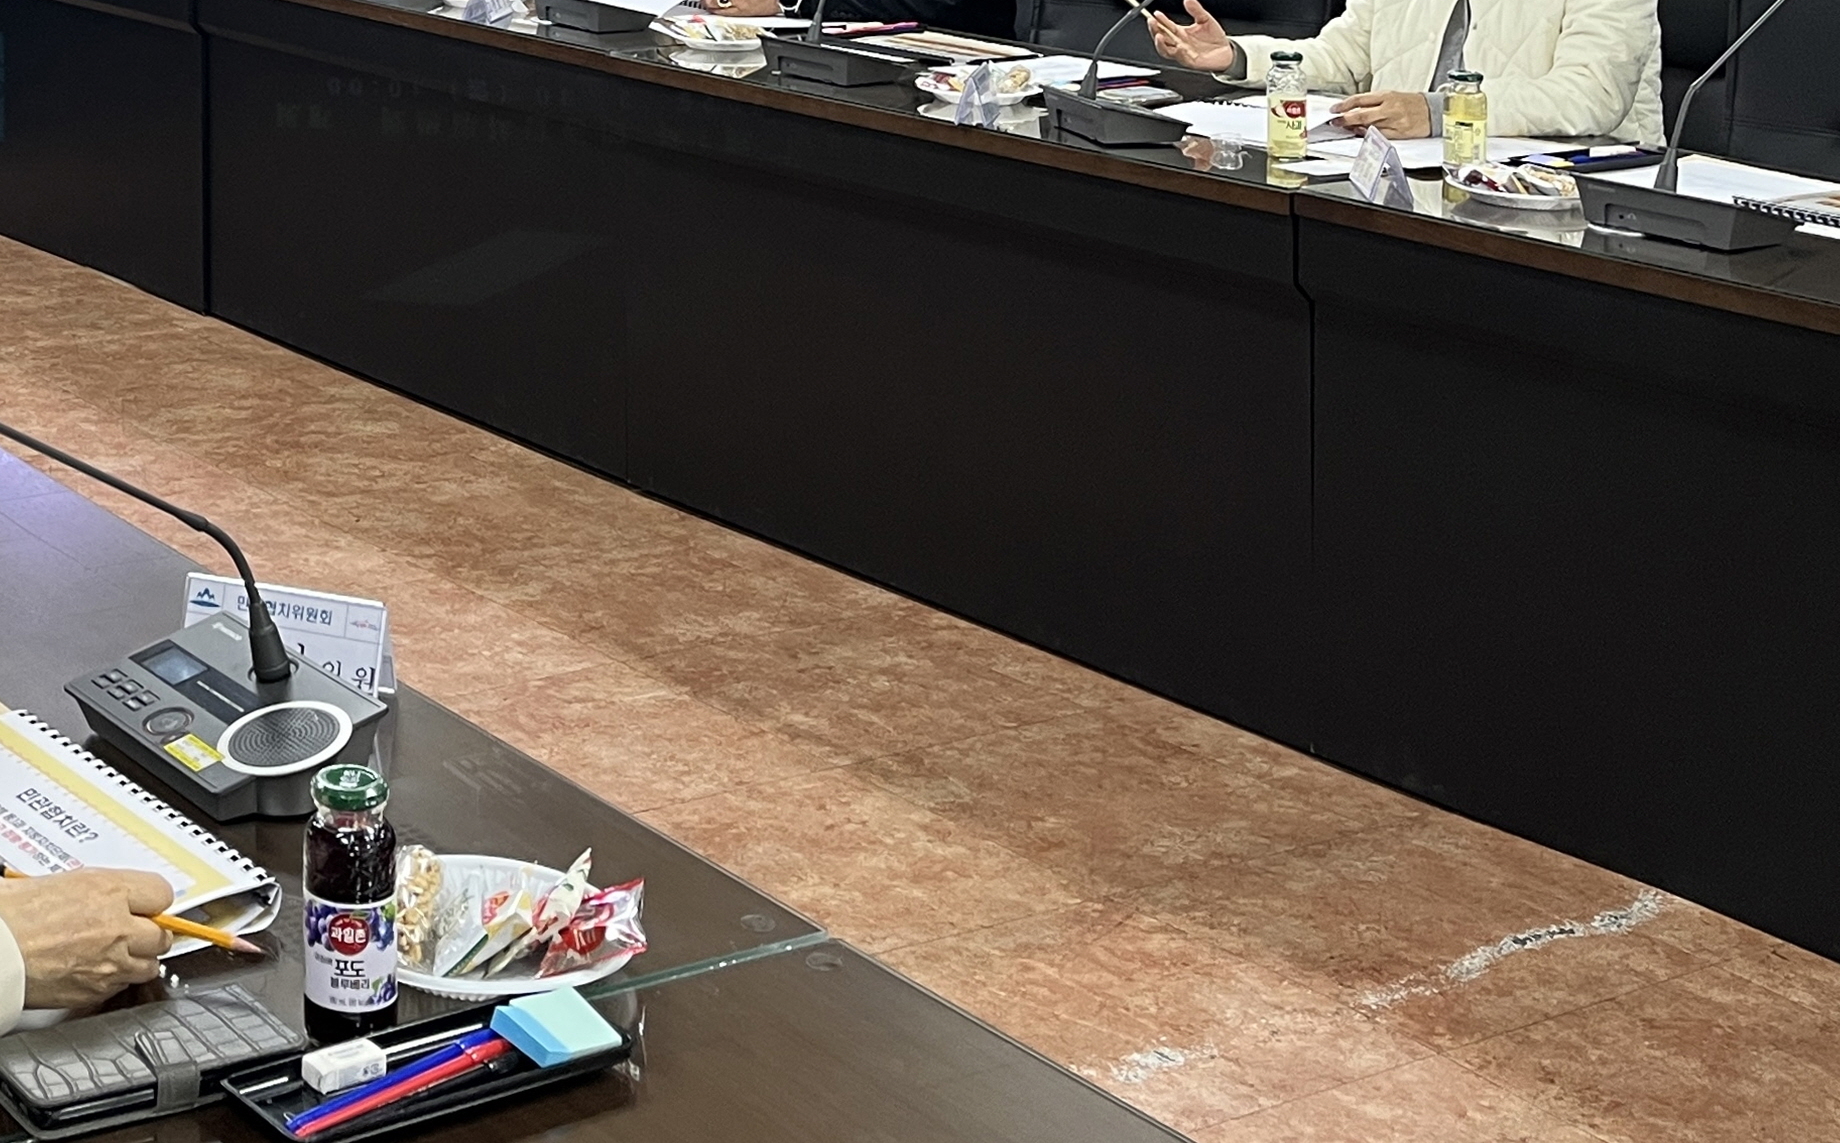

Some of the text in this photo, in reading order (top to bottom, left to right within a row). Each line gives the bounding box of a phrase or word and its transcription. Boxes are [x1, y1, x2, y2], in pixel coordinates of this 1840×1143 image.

[1286, 120, 1302, 130] 사과
[237, 595, 332, 626] 민협치위원회
[16, 788, 99, 844] 민관협치란?
[333, 959, 366, 978] 포도
